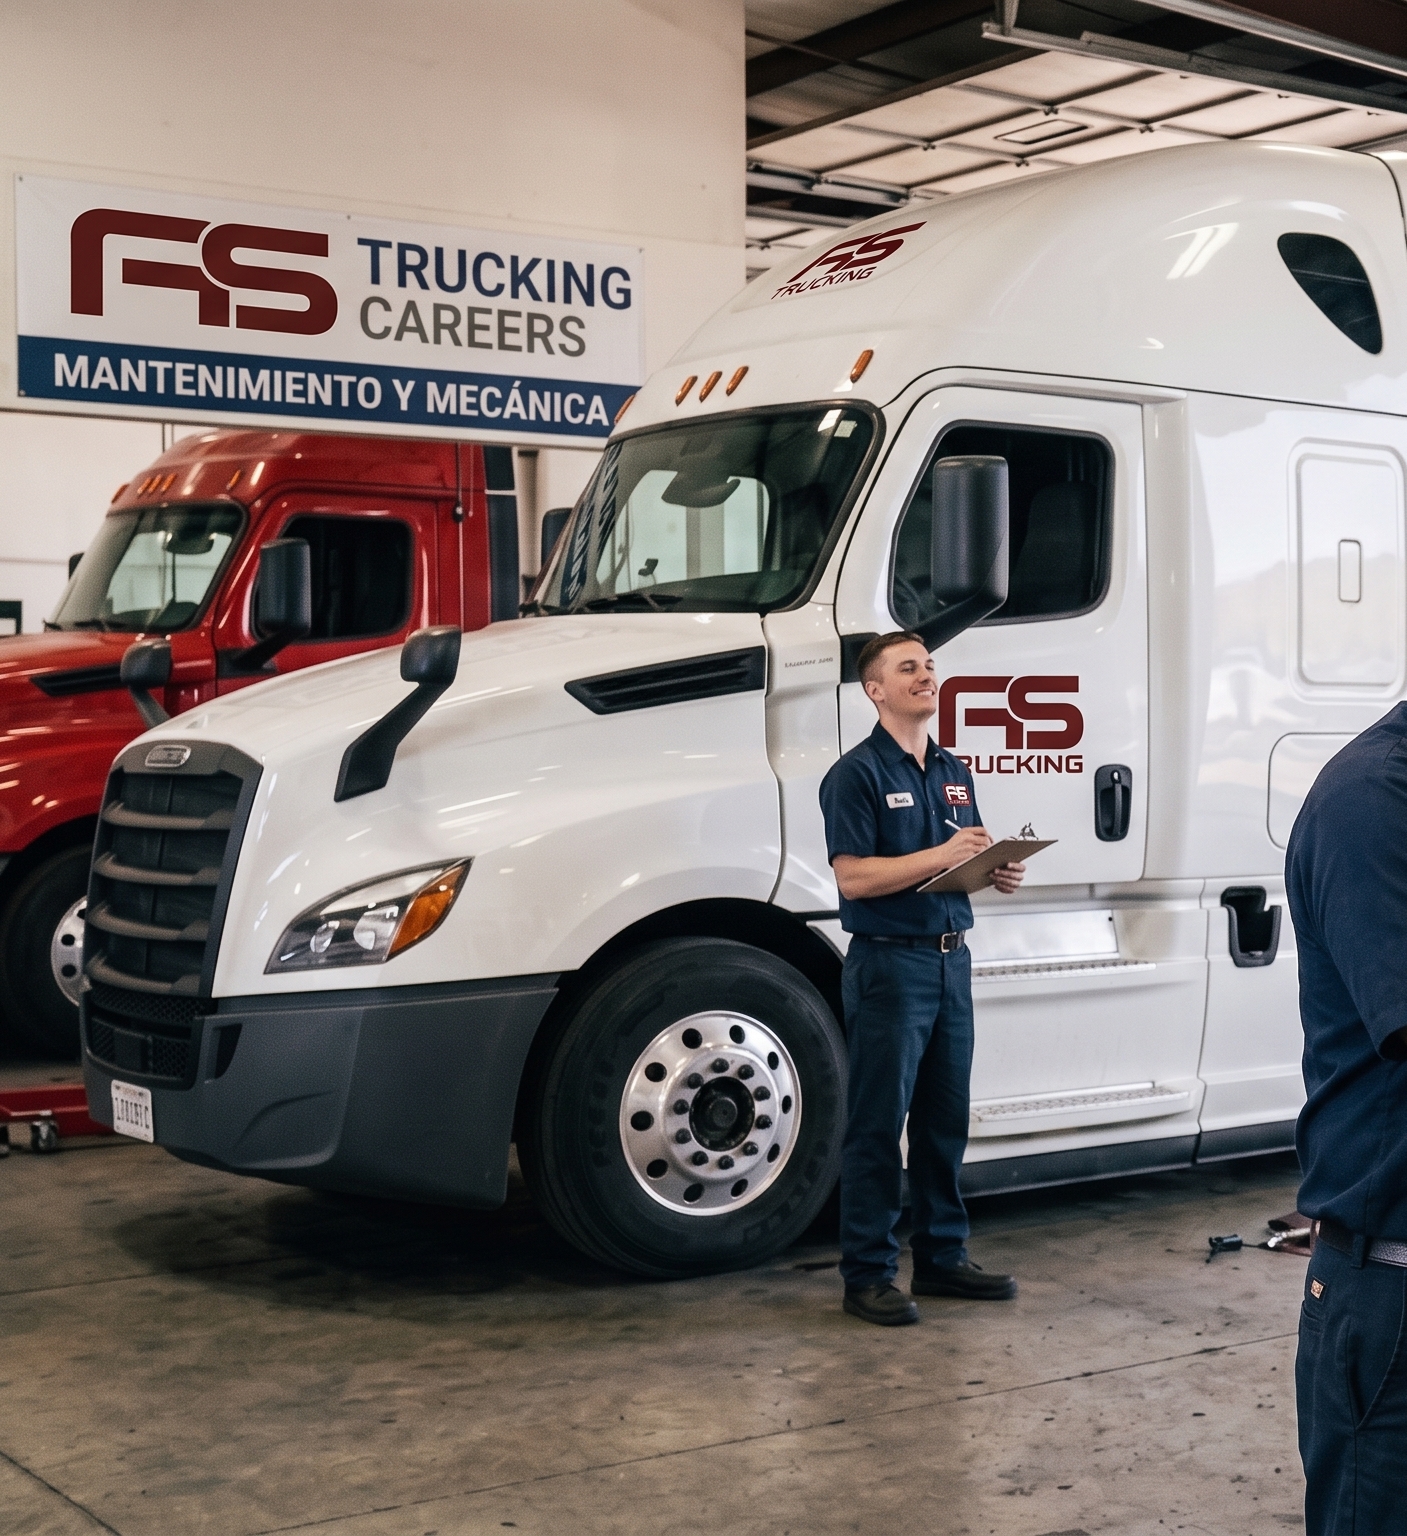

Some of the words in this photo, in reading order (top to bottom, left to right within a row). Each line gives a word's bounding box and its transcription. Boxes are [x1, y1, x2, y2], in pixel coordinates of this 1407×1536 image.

[357, 237, 632, 311] TRUCKING
[771, 266, 877, 300] TRUCKING
[360, 295, 587, 358] CAREERS
[54, 353, 382, 409] MANTENIMIENTO
[393, 379, 416, 411] Y
[426, 380, 610, 426] MECÁNICA
[955, 755, 1083, 774] RUCKING
